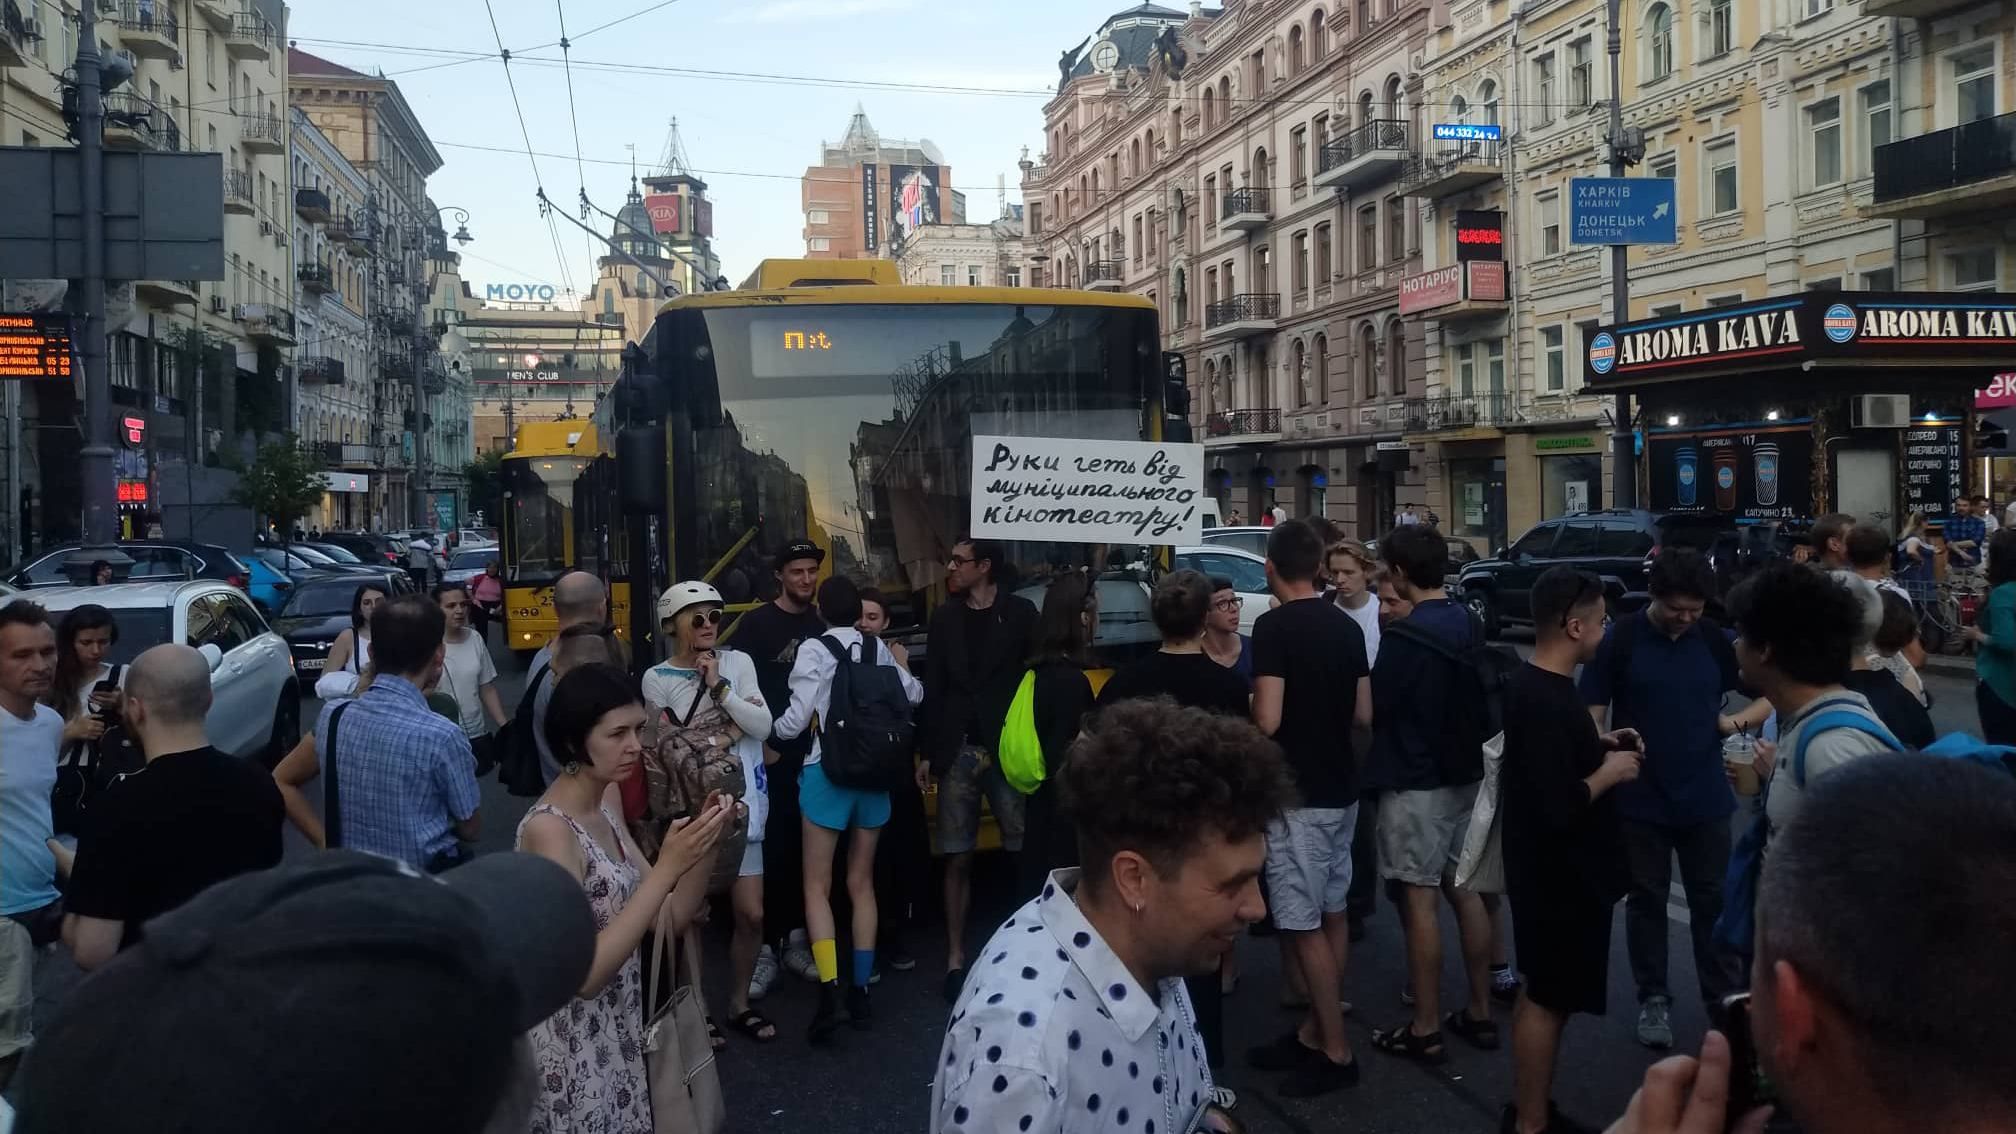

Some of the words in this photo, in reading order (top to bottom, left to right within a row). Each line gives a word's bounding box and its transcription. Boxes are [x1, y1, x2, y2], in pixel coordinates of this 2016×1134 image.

[1437, 127, 1454, 137] 044
[1456, 128, 1473, 138] 332
[1578, 186, 1631, 198] ХАРКІВ
[1578, 200, 1621, 208] KHARKIV
[652, 208, 673, 219] KIA
[1578, 215, 1646, 228] ДОНЕЦЬК
[1578, 229, 1623, 238] DONETSK
[1402, 267, 1458, 294] НОТАРІУС
[486, 284, 555, 301] MOYO
[1860, 311, 1960, 337] AROMA
[1618, 324, 1710, 365] AROMA
[1717, 310, 1800, 352] KAVA
[537, 371, 559, 380] CLUB
[1950, 430, 1960, 442] 15
[1950, 445, 1959, 456] 17
[984, 442, 1060, 472] Руки
[1073, 456, 1136, 474] геть
[1142, 449, 1187, 485] від
[986, 478, 1198, 503] муніципального
[1745, 508, 1780, 518] КАПУЧИНО
[983, 505, 1195, 536] кінотеатру!
